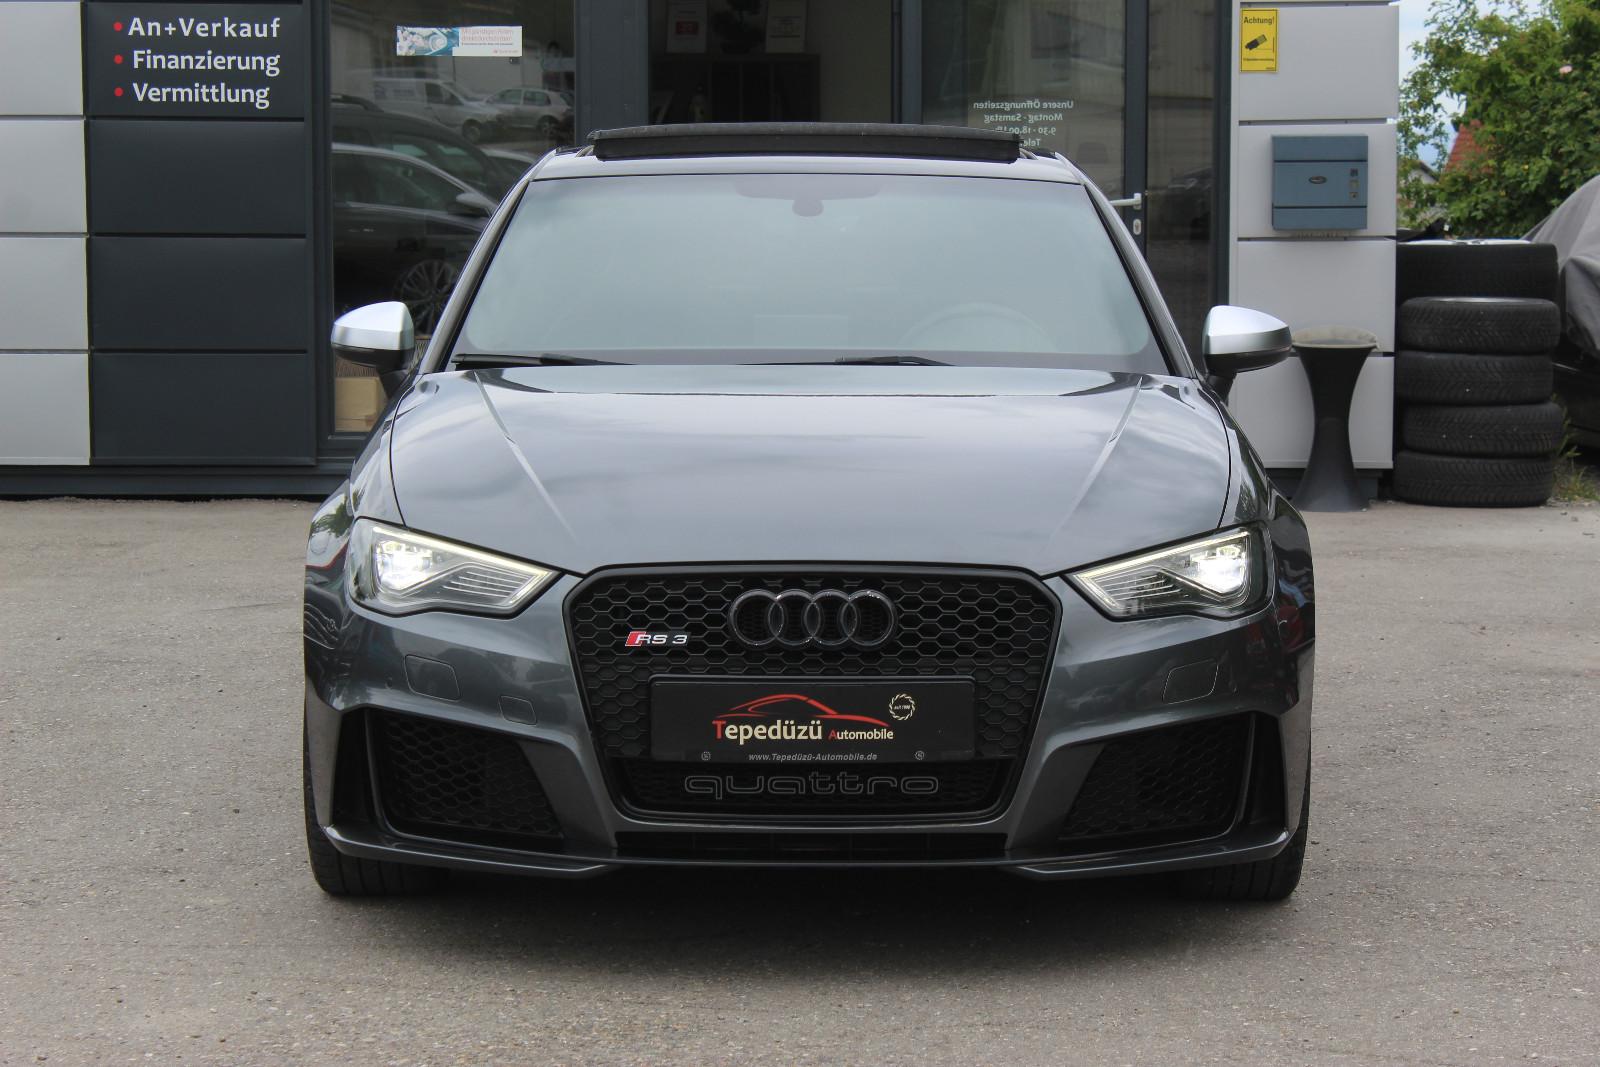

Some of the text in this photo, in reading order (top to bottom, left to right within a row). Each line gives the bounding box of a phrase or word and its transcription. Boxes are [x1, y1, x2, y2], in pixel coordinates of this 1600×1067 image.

[127, 16, 281, 38] An+Verkauf
[1243, 16, 1275, 26] Achtung!
[133, 49, 281, 77] Finanzierung
[132, 82, 270, 109] Vermittlung
[712, 719, 894, 745] Tepedüzü Automobile
[684, 771, 939, 800] quattro
